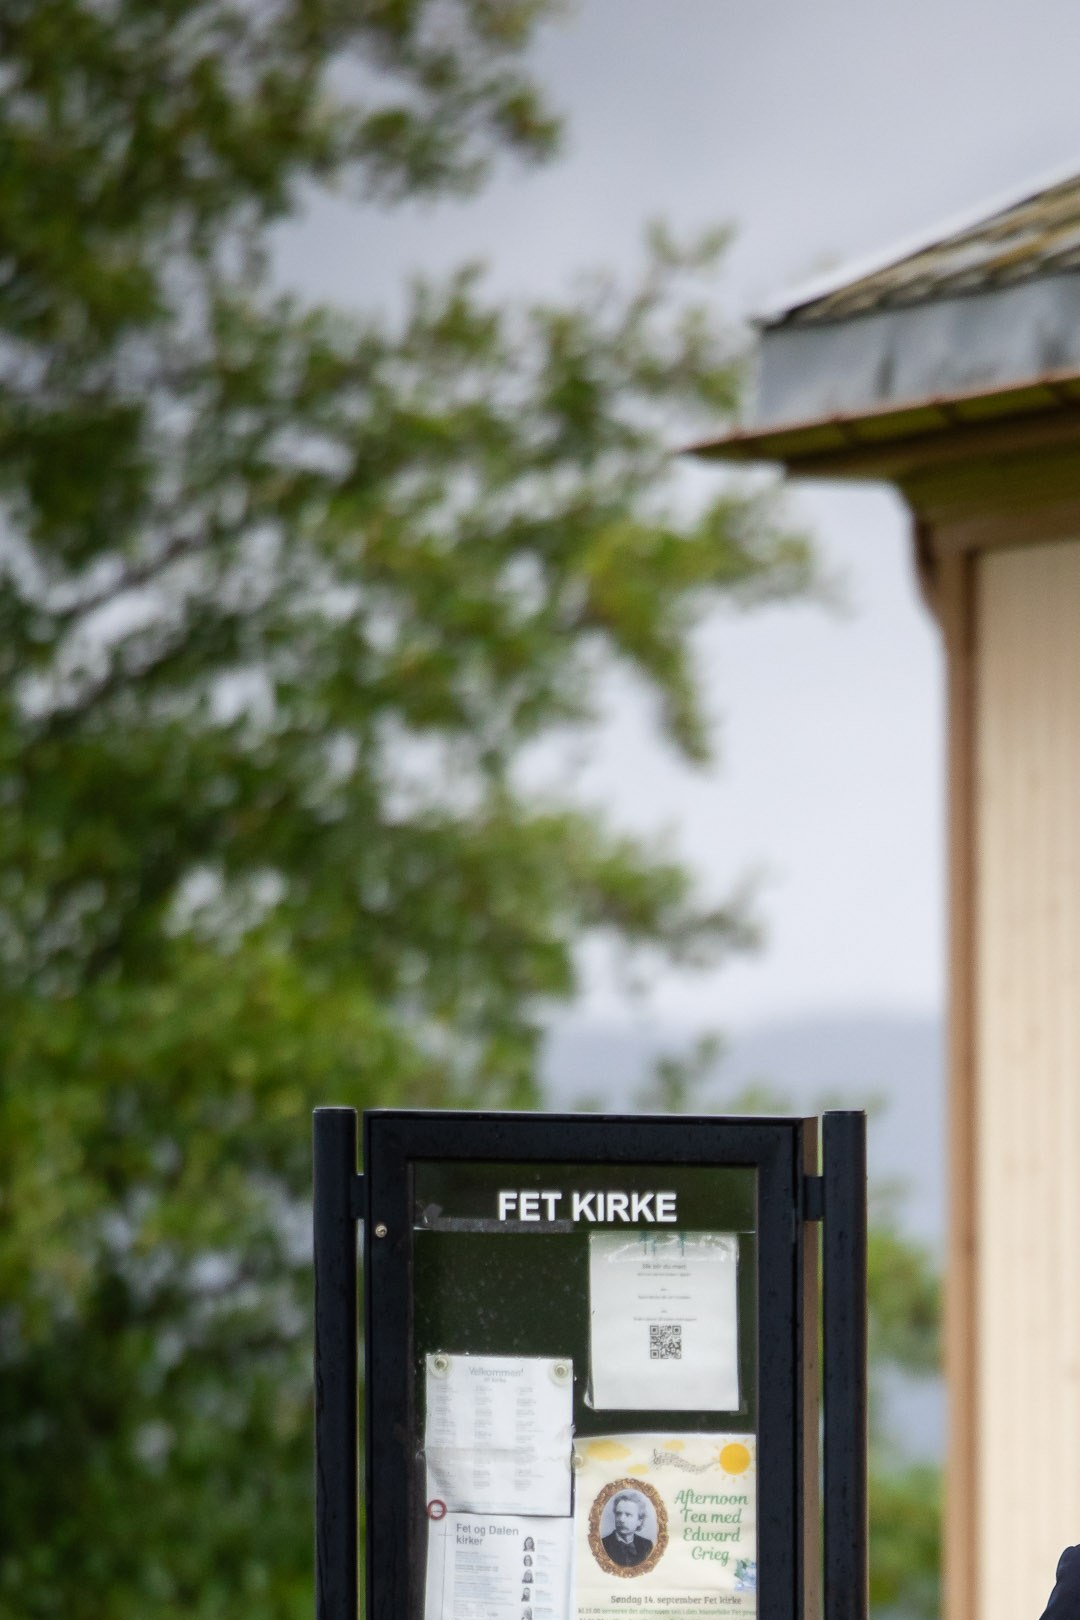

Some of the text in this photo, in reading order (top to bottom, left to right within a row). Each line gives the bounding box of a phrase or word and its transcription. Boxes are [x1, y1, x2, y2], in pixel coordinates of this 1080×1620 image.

[499, 1191, 678, 1223] FET KIRKE
[674, 1489, 748, 1508] Afternoon
[680, 1508, 743, 1524] Tea med
[456, 1523, 519, 1536] Fet og Dalen
[683, 1526, 741, 1542] Edward
[456, 1535, 483, 1546] kirker
[692, 1546, 730, 1567] Grieg
[610, 1595, 642, 1605] Søndag
[657, 1595, 702, 1605] september
[704, 1596, 718, 1604] Fet
[719, 1596, 742, 1604] kirke
